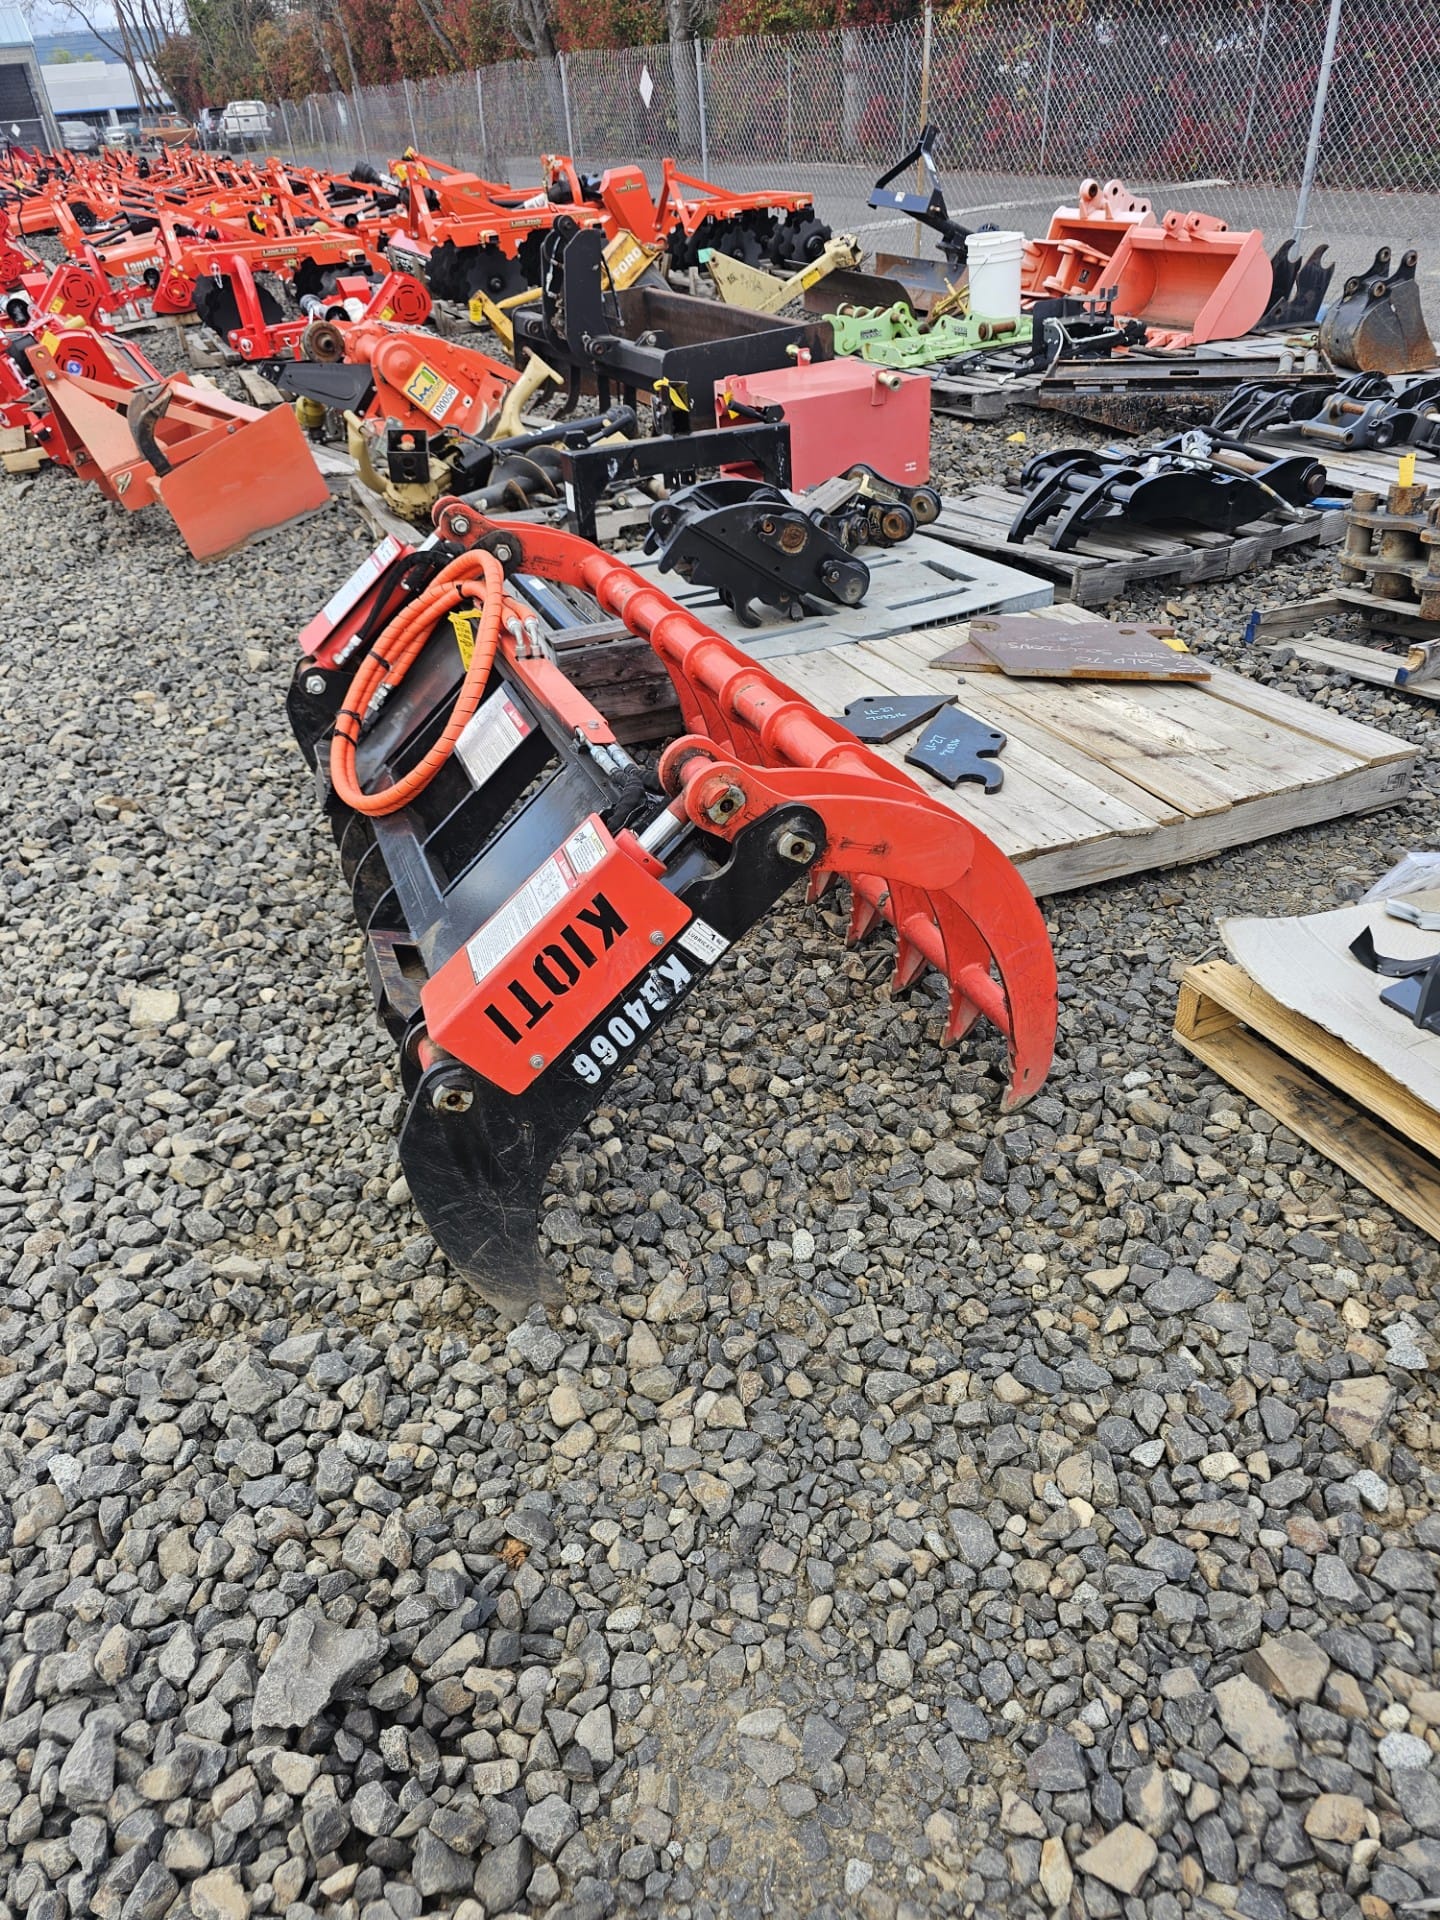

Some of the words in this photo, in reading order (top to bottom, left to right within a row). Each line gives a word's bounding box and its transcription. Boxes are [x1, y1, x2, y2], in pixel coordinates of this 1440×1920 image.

[123, 257, 151, 274] Land
[612, 246, 643, 279] FORD
[433, 386, 457, 418] 100058
[1075, 655, 1105, 665] TO
[1114, 657, 1164, 668] SOLD
[483, 891, 629, 1045] KIOTI
